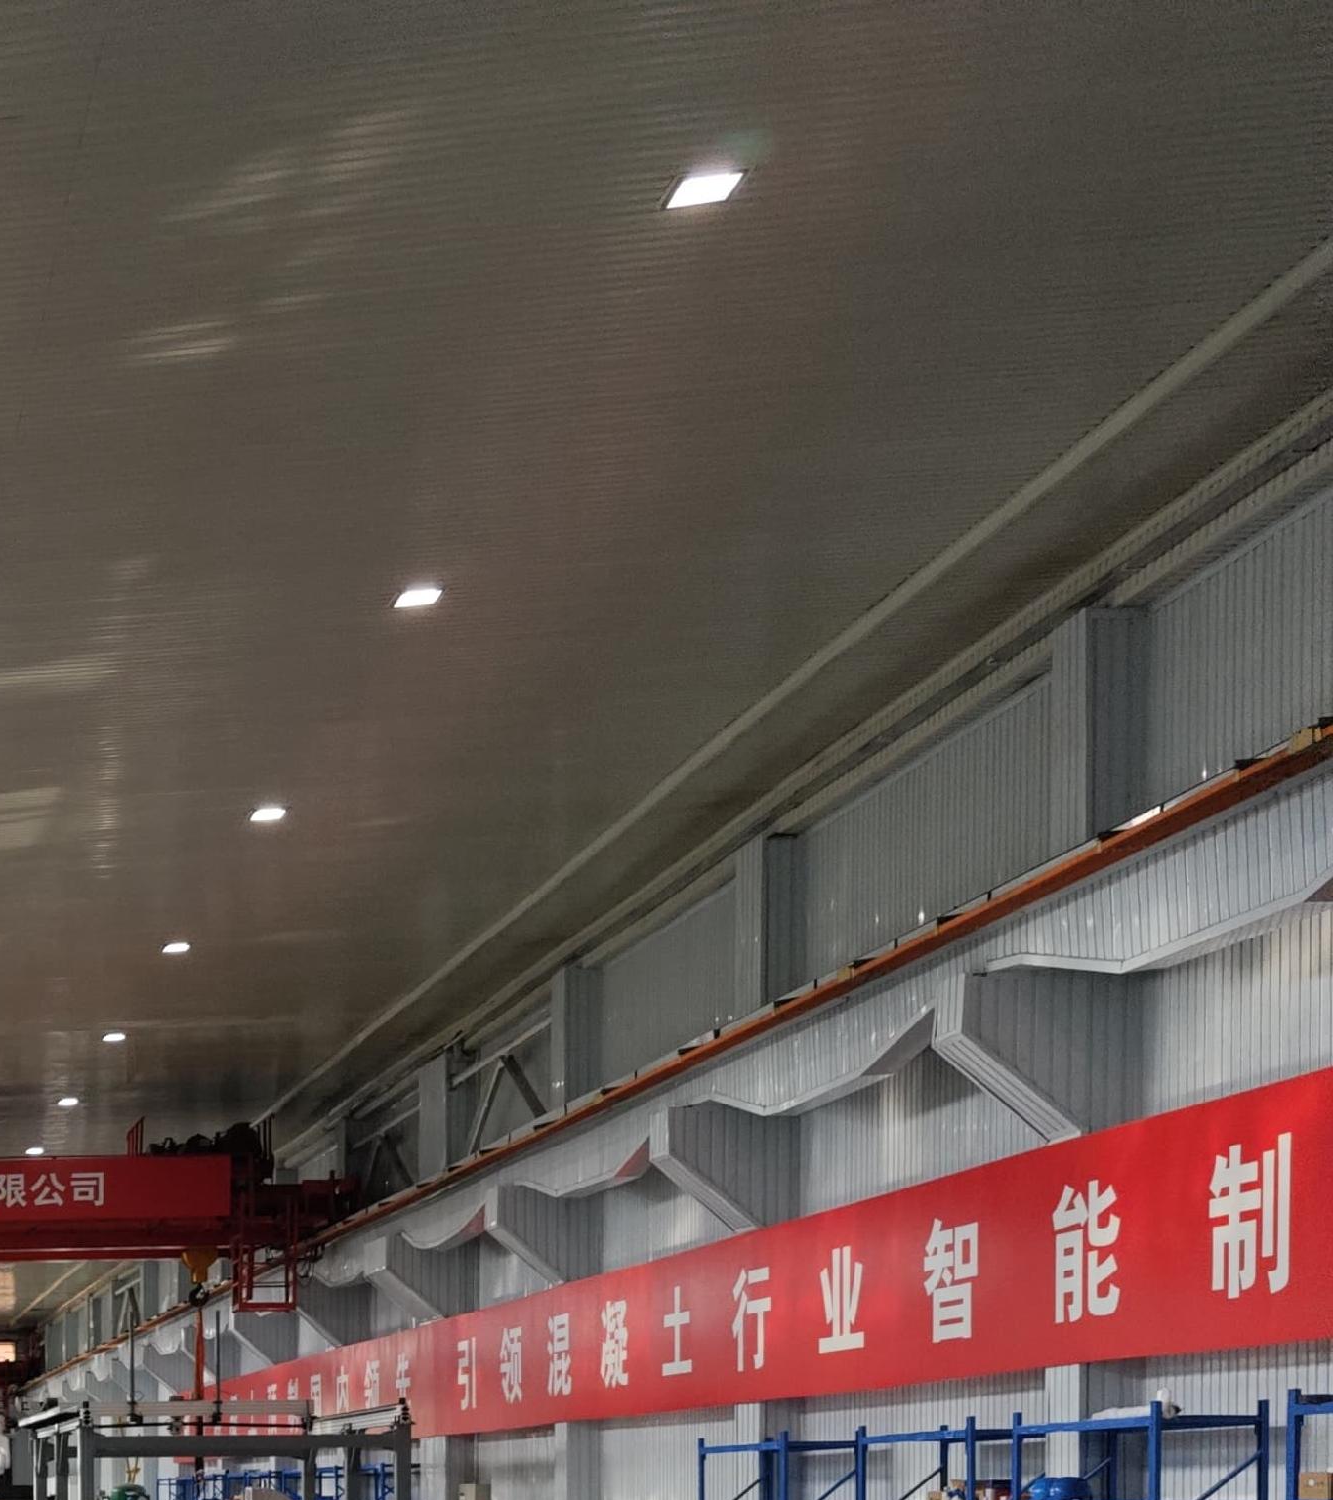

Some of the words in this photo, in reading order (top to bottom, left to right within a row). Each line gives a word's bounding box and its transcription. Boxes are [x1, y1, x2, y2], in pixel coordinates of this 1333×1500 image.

[456, 1131, 1292, 1410] 引领混凝土行业智能制
